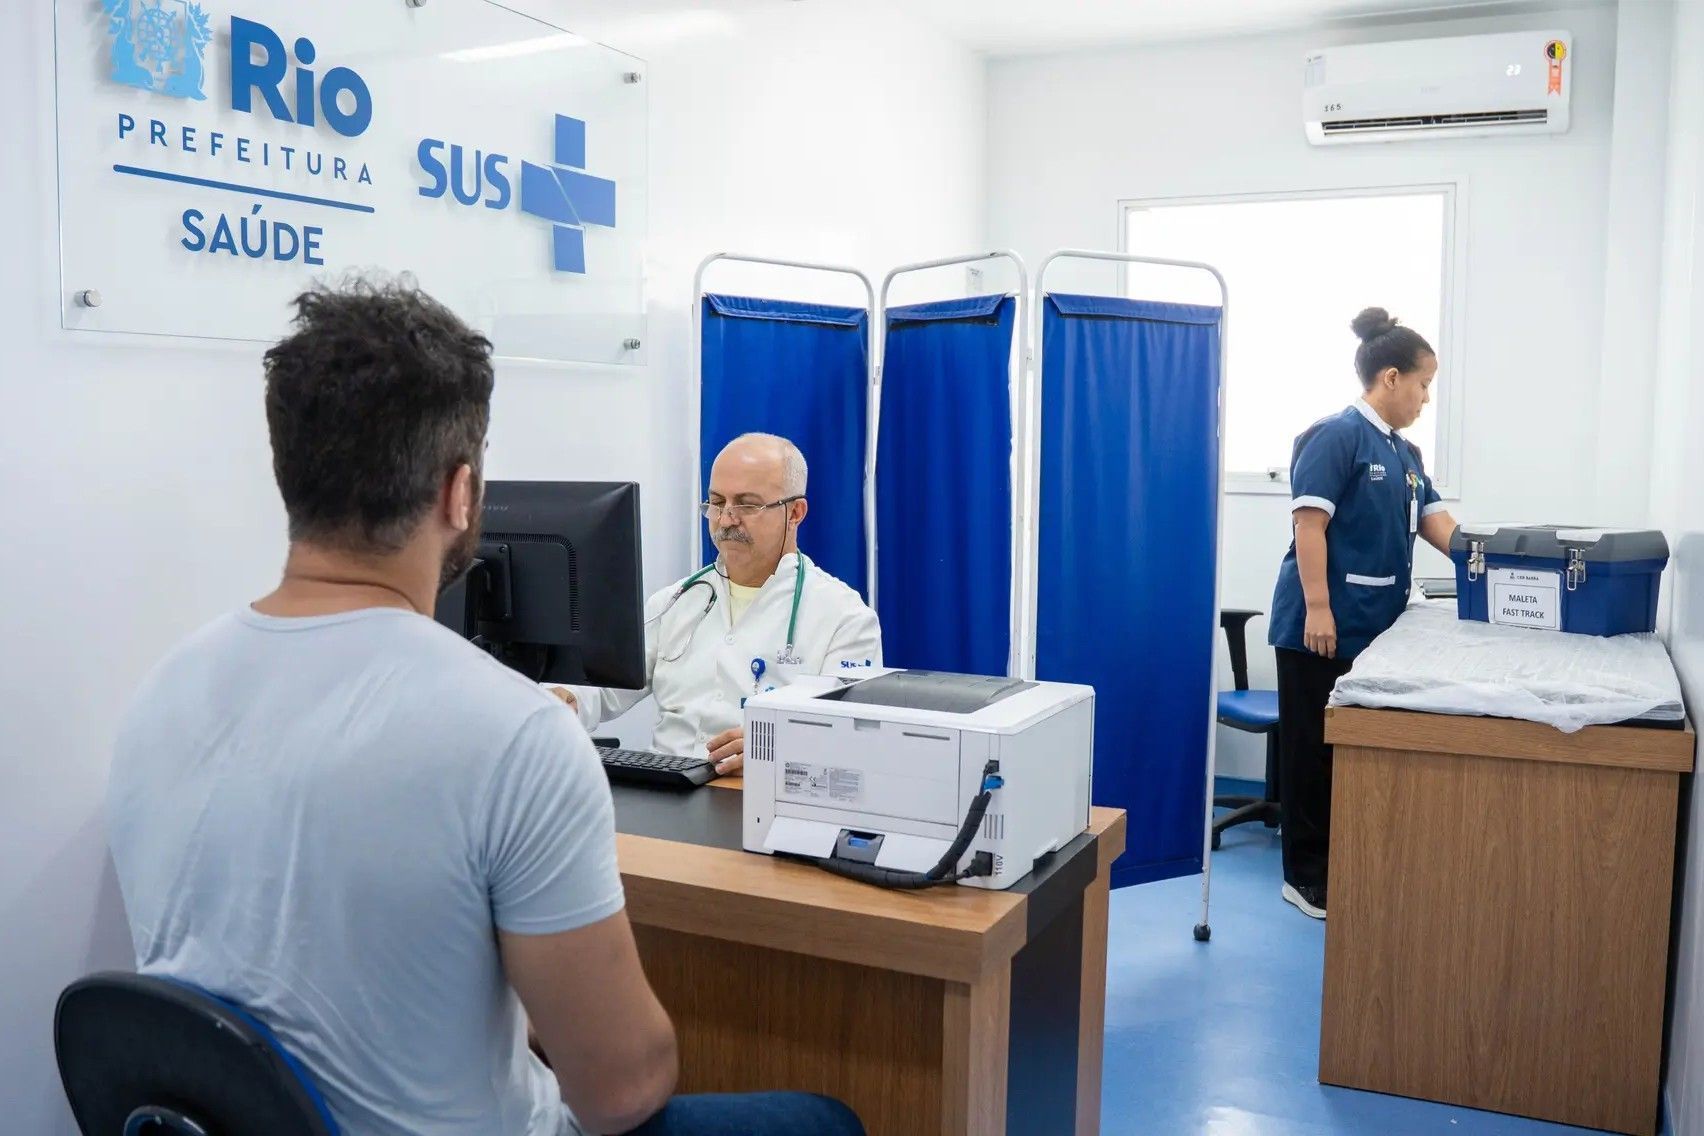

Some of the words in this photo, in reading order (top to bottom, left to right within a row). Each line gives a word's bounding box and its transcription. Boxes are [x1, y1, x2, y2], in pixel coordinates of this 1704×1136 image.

[230, 15, 373, 137] Rio
[118, 113, 373, 185] PREFEITURA
[417, 138, 512, 210] SUS
[181, 205, 325, 266] SAÚDE
[1502, 607, 1519, 616] FAST
[1521, 609, 1544, 618] TRACK
[1508, 594, 1538, 603] MALETA
